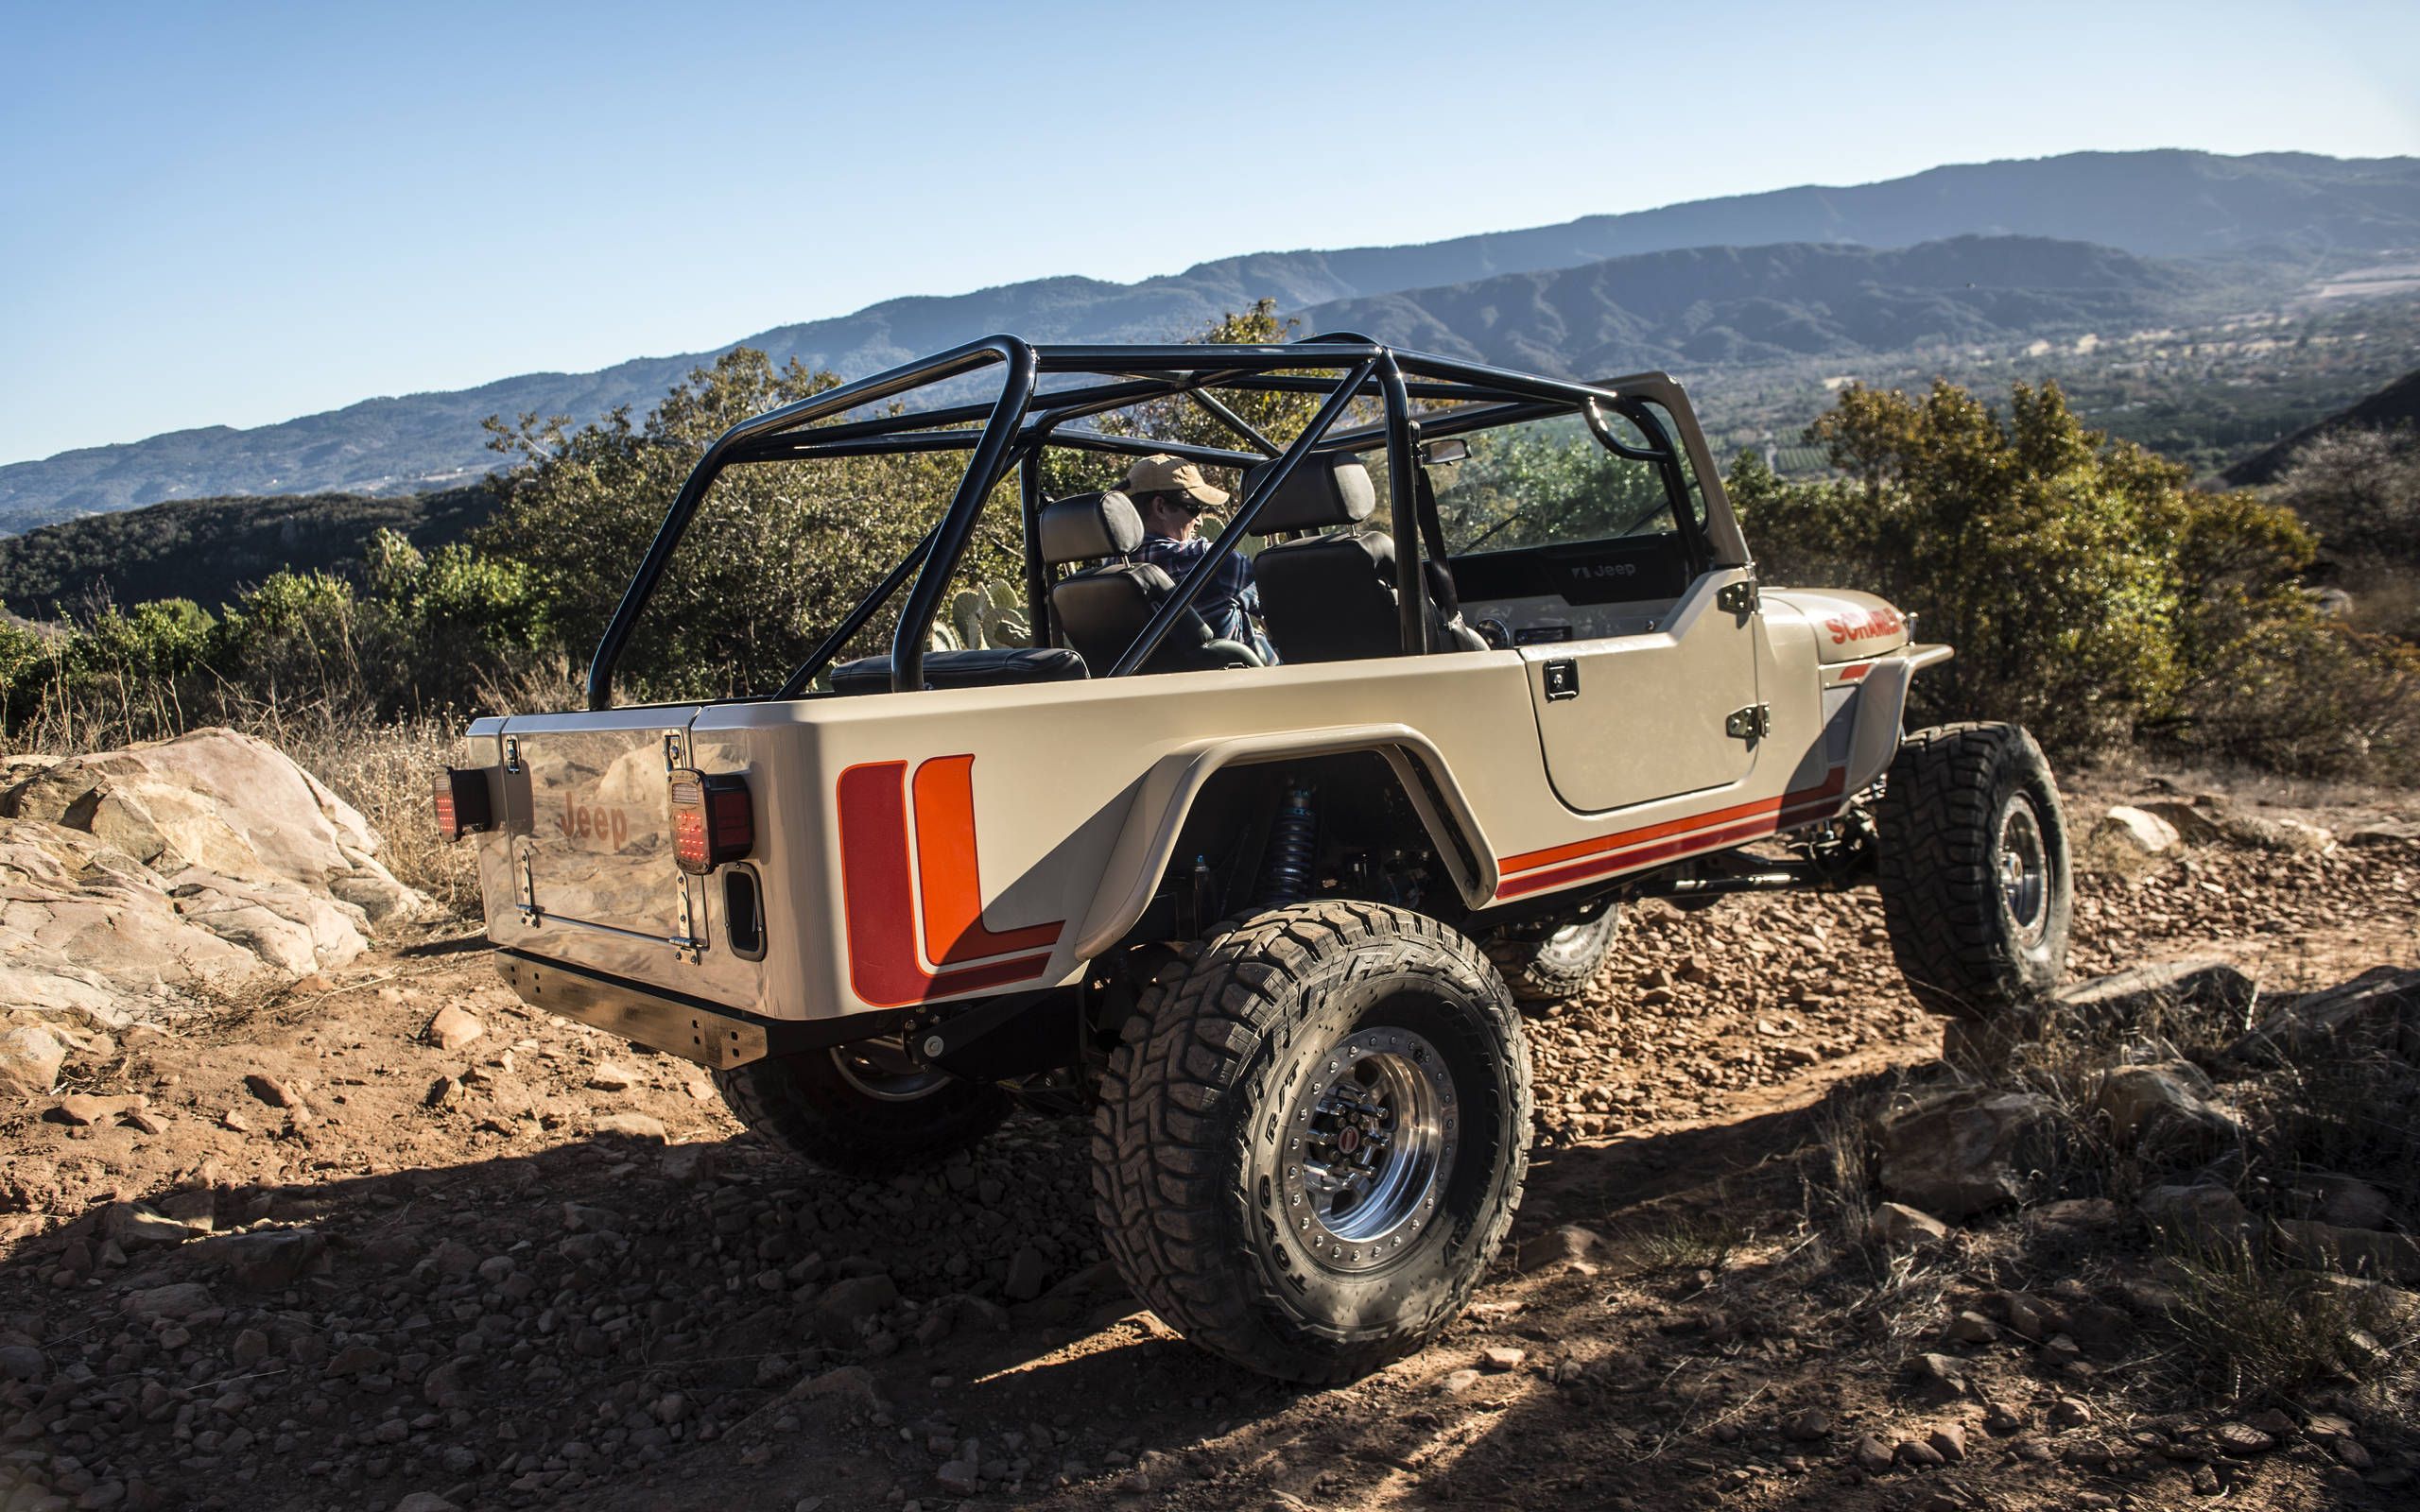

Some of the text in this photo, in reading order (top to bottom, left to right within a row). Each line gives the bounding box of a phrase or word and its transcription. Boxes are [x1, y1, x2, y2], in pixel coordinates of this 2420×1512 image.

[1594, 563, 1636, 577] Jeep
[560, 791, 628, 850] Jeep
[1265, 1058, 1301, 1144] R/T
[1260, 1174, 1307, 1296] TOYO
